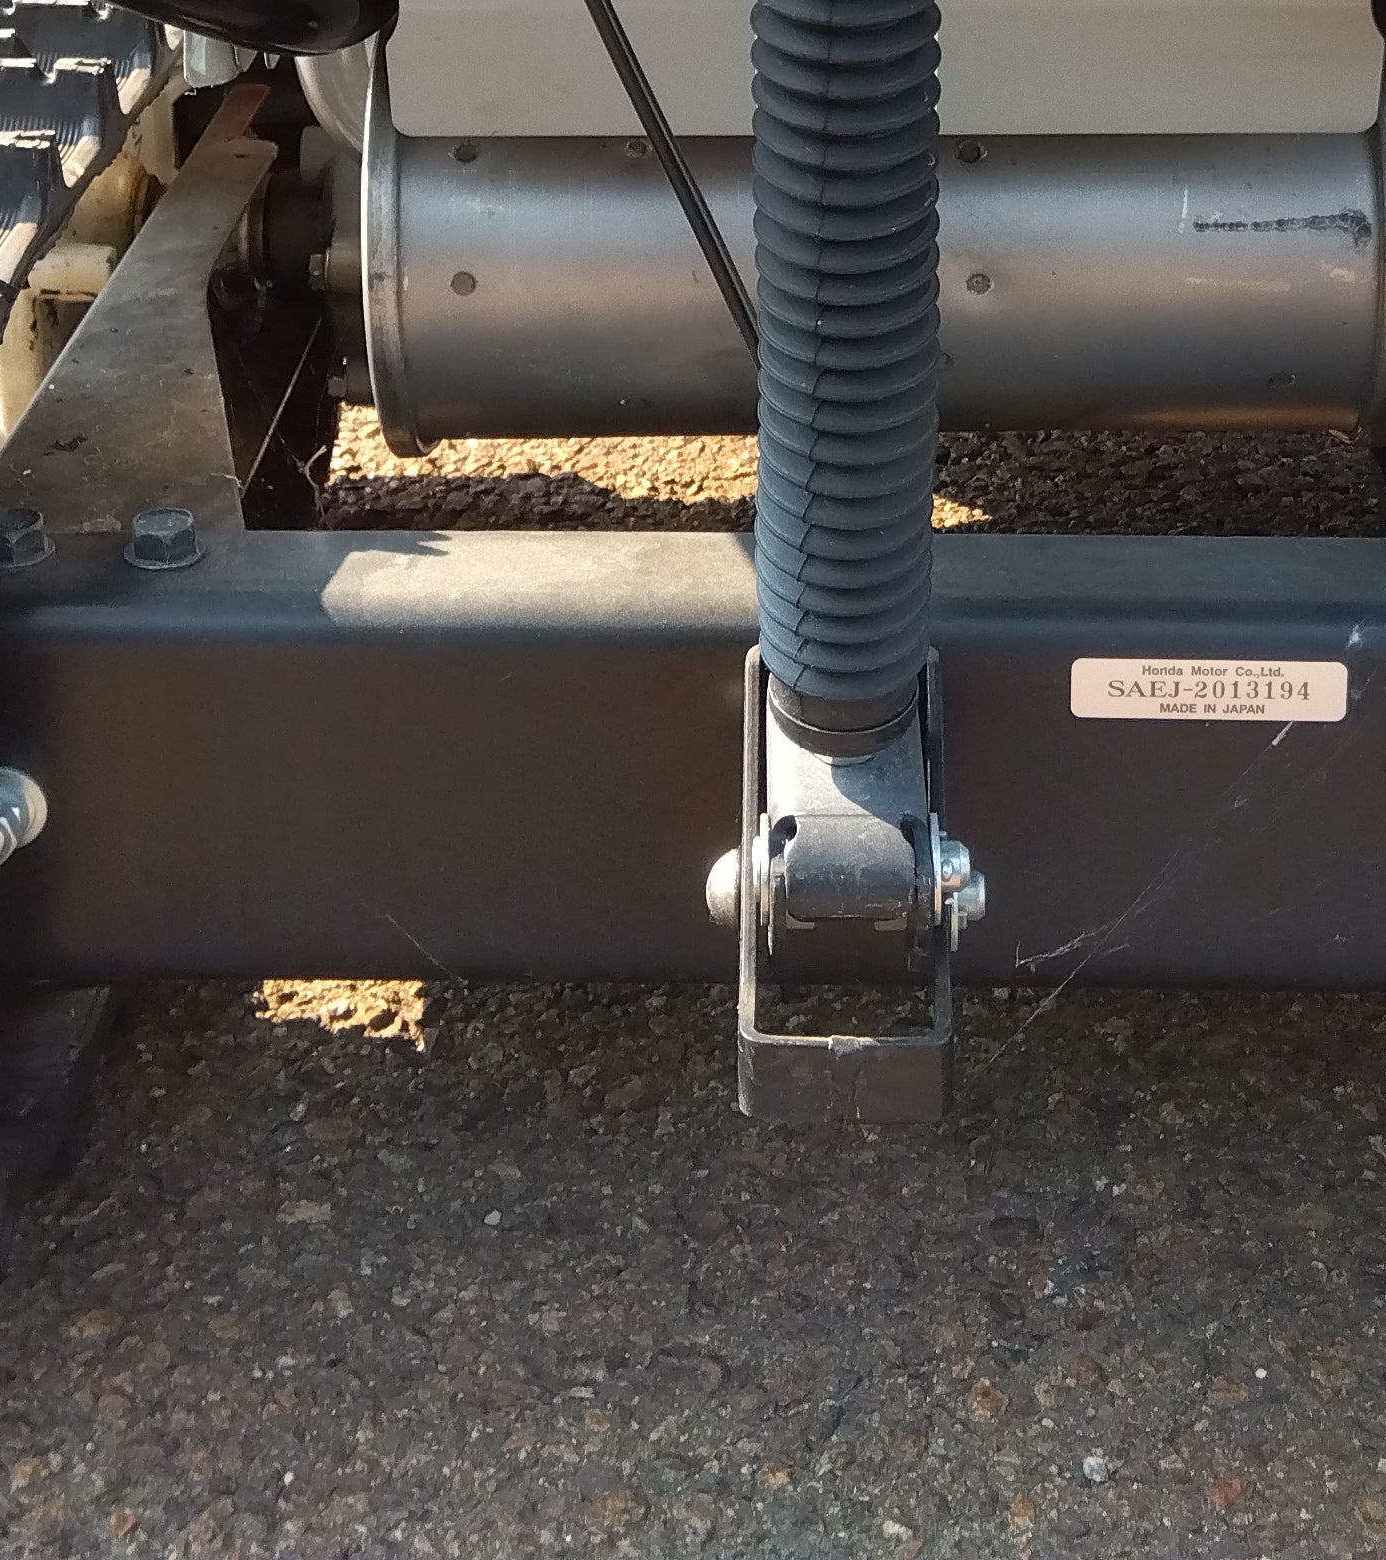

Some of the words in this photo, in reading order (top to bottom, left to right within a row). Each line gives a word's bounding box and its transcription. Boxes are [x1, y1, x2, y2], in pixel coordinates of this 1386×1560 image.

[1142, 665, 1184, 676] Honda
[1191, 666, 1228, 677] Motor
[1107, 679, 1311, 701] SAEJ-2013194
[1159, 703, 1197, 714] MADE
[1203, 704, 1216, 714] IN
[1222, 703, 1265, 715] JAPAN
